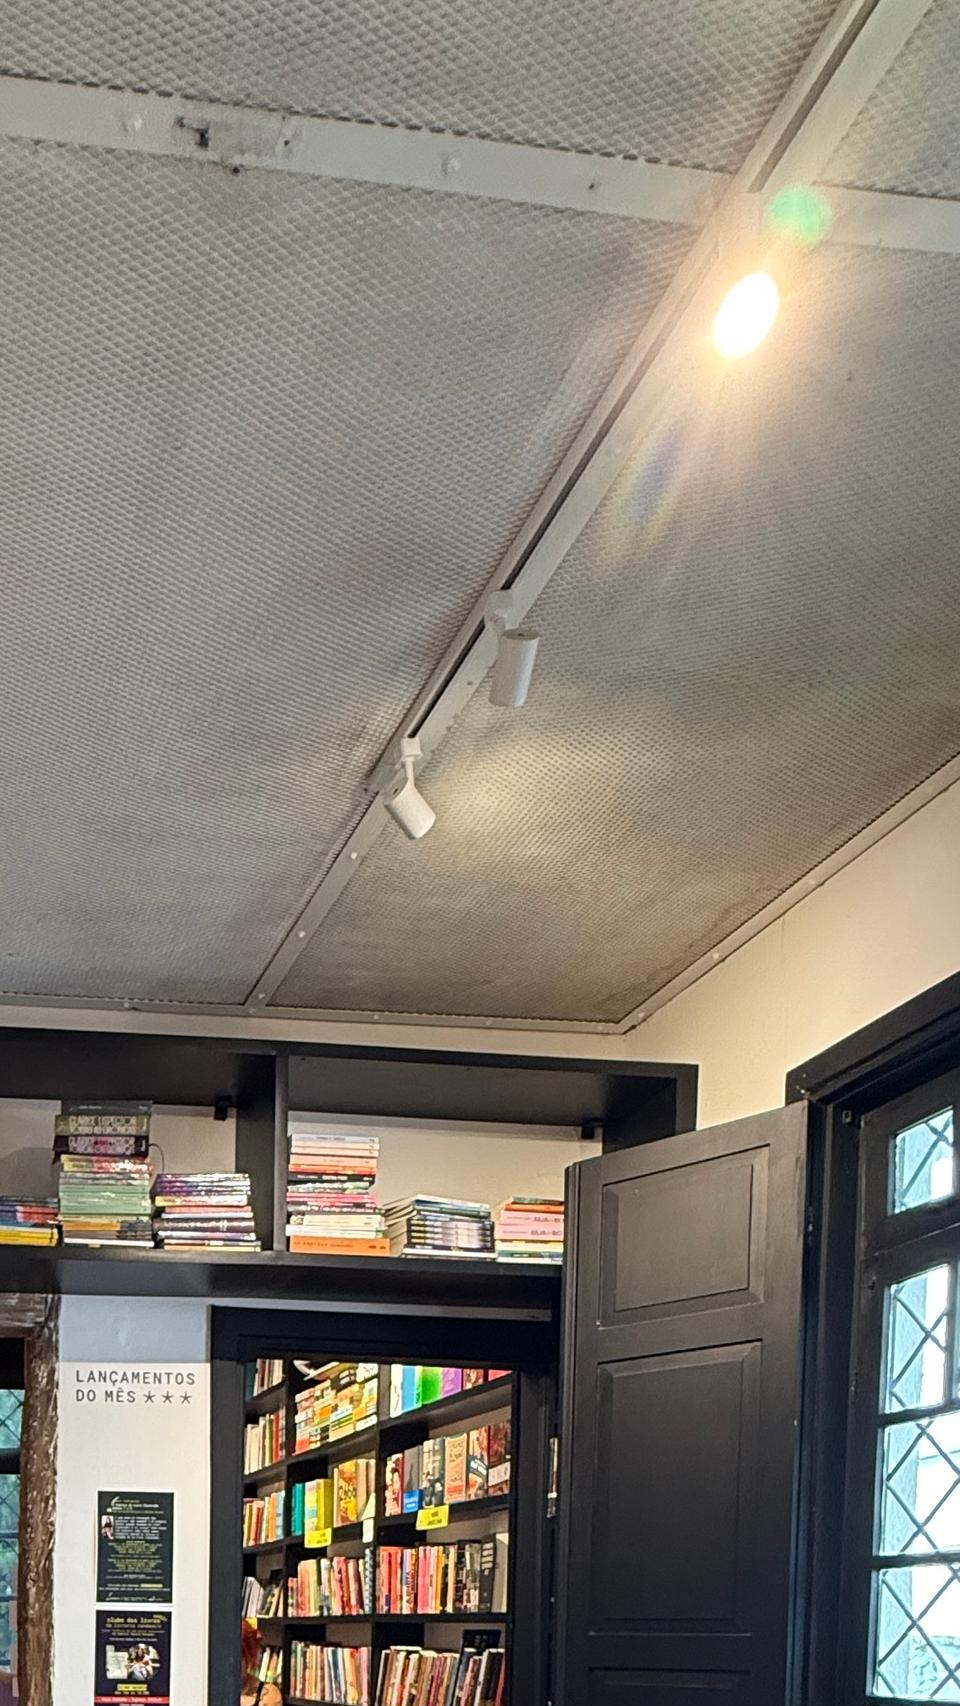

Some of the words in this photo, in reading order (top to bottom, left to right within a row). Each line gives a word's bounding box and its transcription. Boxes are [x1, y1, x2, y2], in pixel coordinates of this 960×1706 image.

[76, 1369, 196, 1386] LANÇAMENTOS
[76, 1389, 97, 1402] DO
[105, 1387, 136, 1403] MÊS
